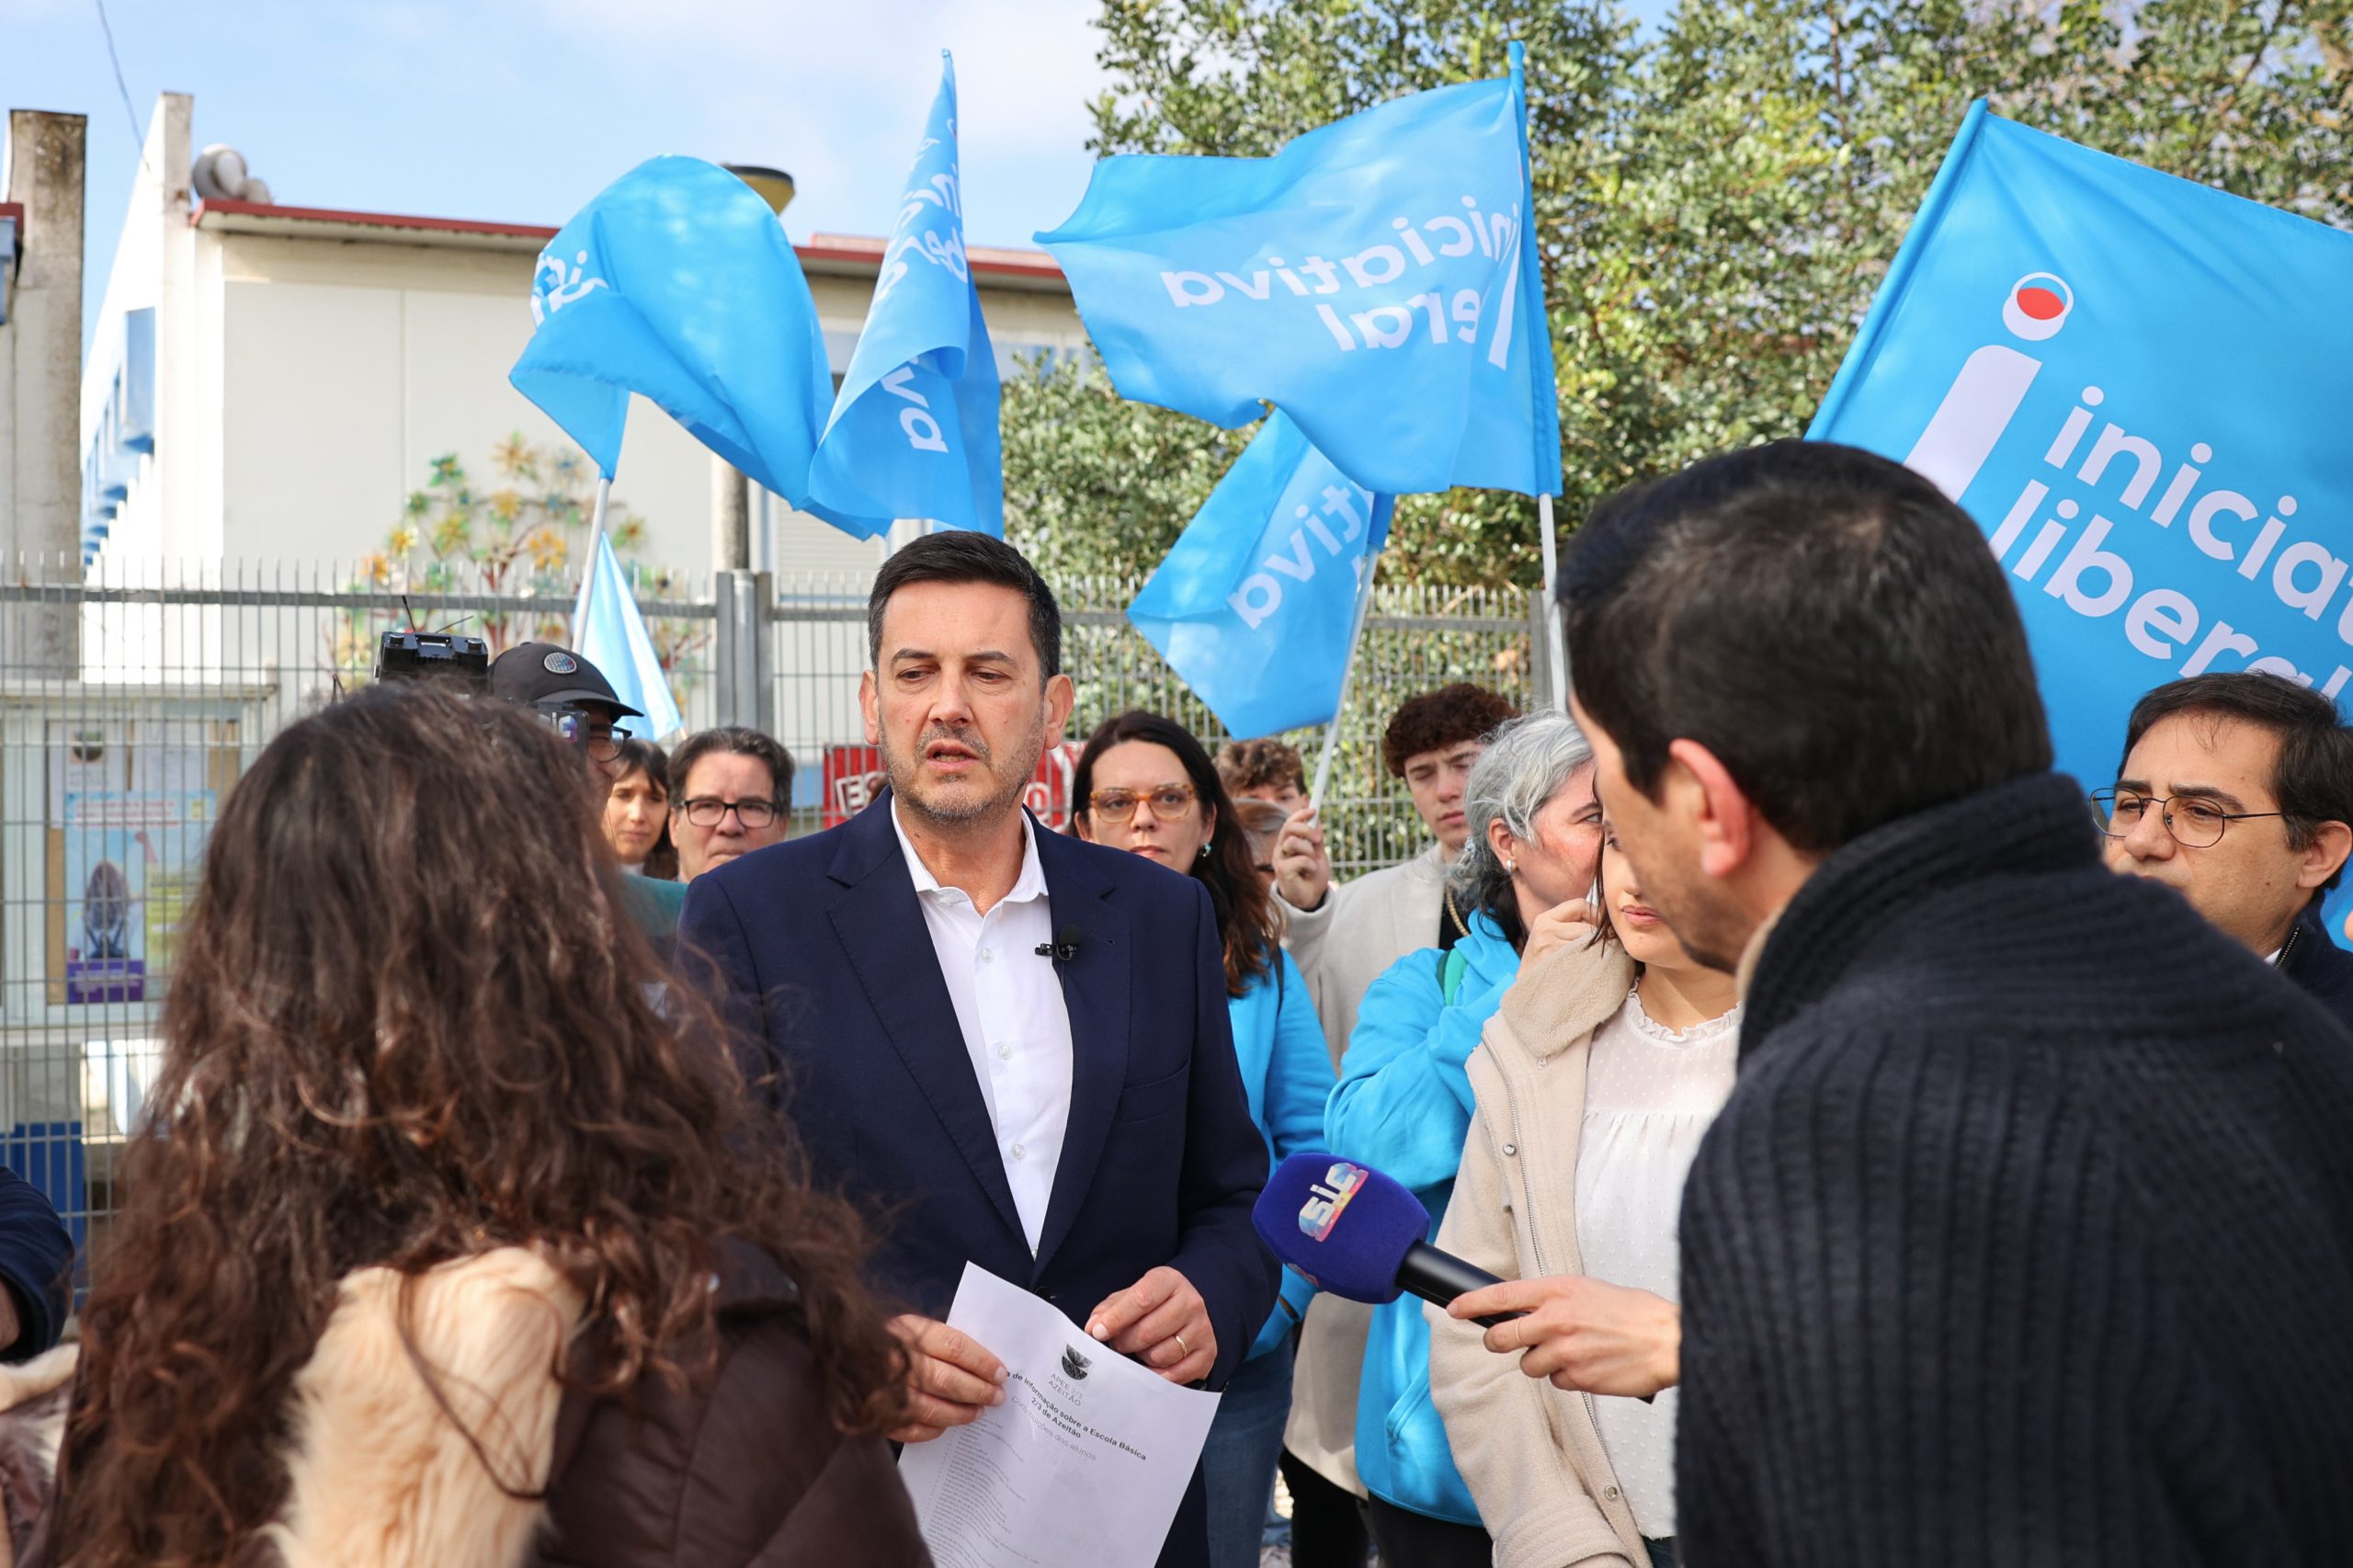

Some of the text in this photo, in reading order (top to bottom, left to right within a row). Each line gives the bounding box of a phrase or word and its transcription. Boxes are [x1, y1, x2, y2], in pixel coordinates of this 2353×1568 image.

[1988, 478, 2353, 700] liber
[1048, 1380, 1081, 1407] AZEITÃO
[1012, 1372, 1023, 1381] de
[1060, 1411, 1082, 1427] sobre
[1089, 1428, 1117, 1446] Escola
[1119, 1441, 1147, 1461] Básica
[1031, 1397, 1081, 1438] 2/3 de Azeitão
[1054, 1434, 1068, 1447] dos
